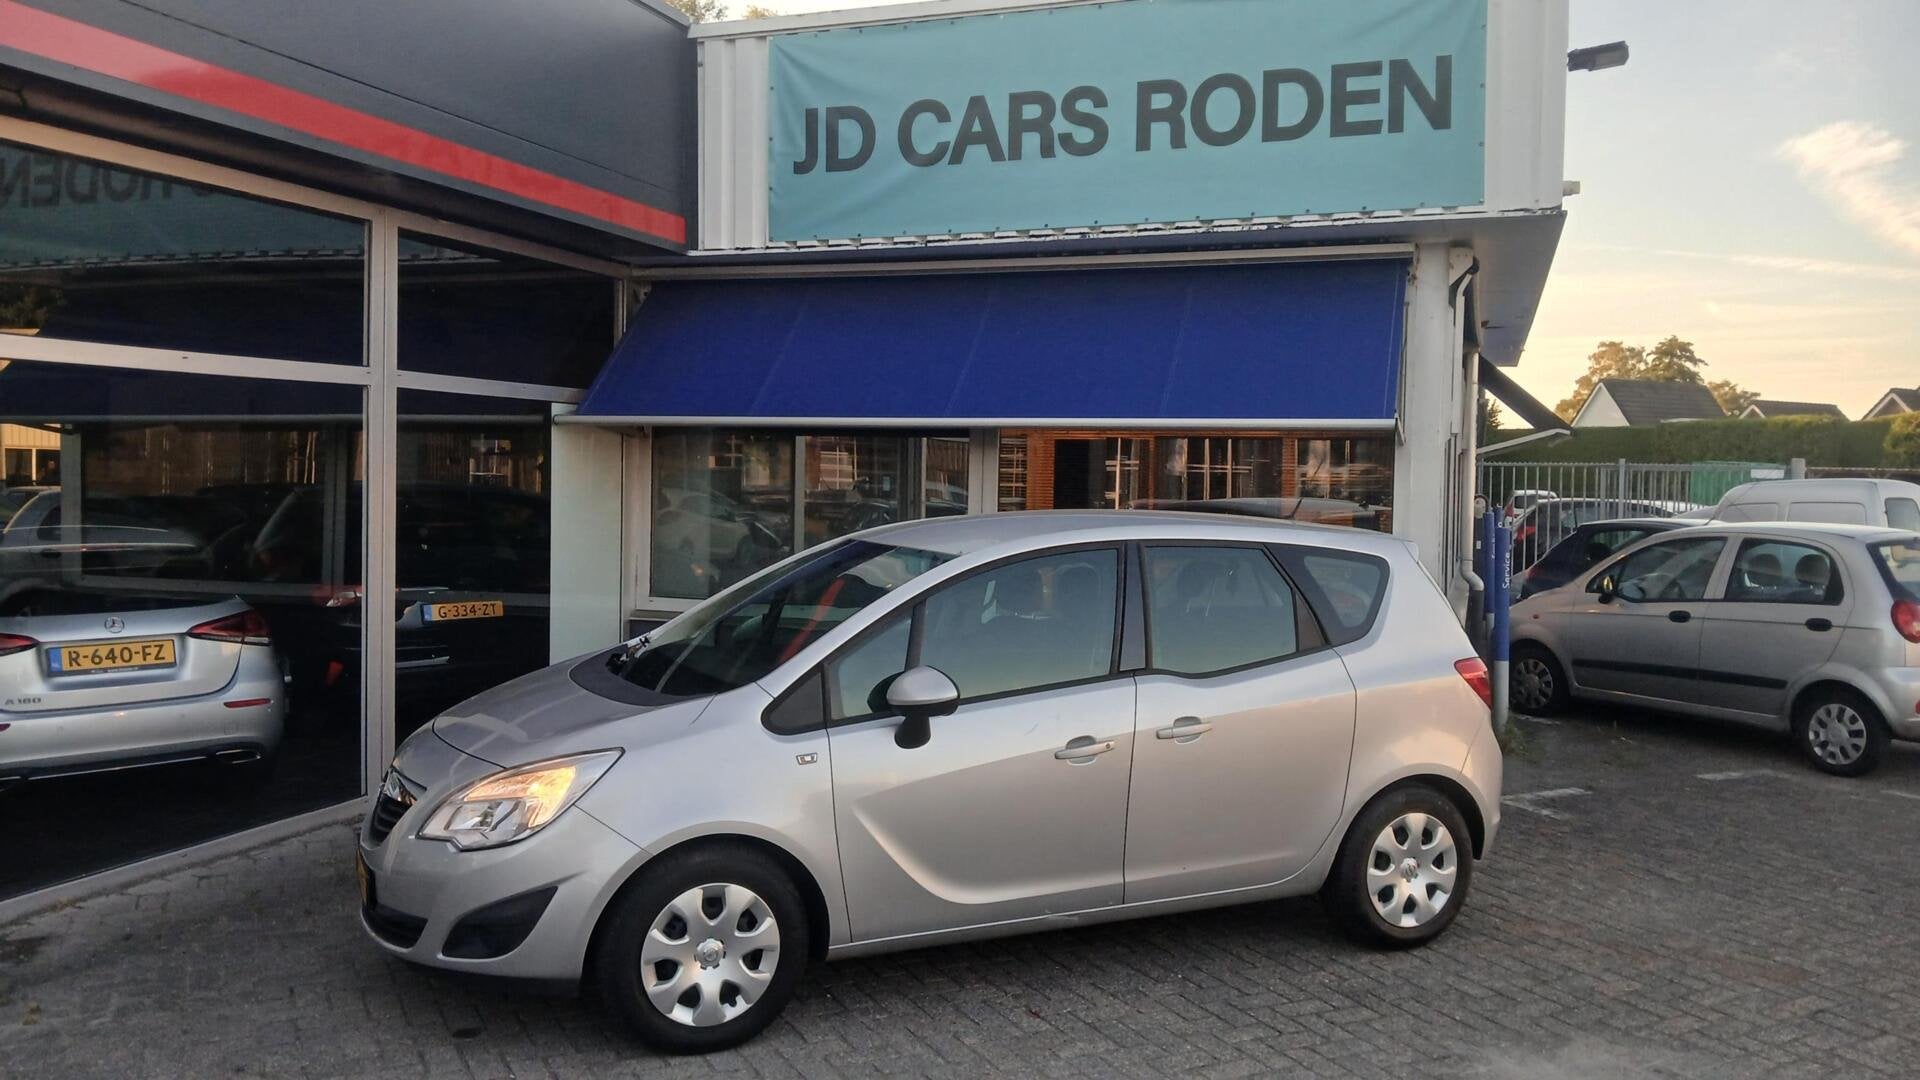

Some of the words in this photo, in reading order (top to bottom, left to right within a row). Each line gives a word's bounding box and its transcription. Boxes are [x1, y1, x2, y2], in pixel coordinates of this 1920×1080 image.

[793, 104, 876, 175] JD
[897, 85, 1110, 168] CARS
[1135, 53, 1453, 152] RODEN
[1502, 552, 1510, 589] Service
[438, 603, 497, 618] G-334-ZT
[67, 643, 165, 668] R-640-FZ
